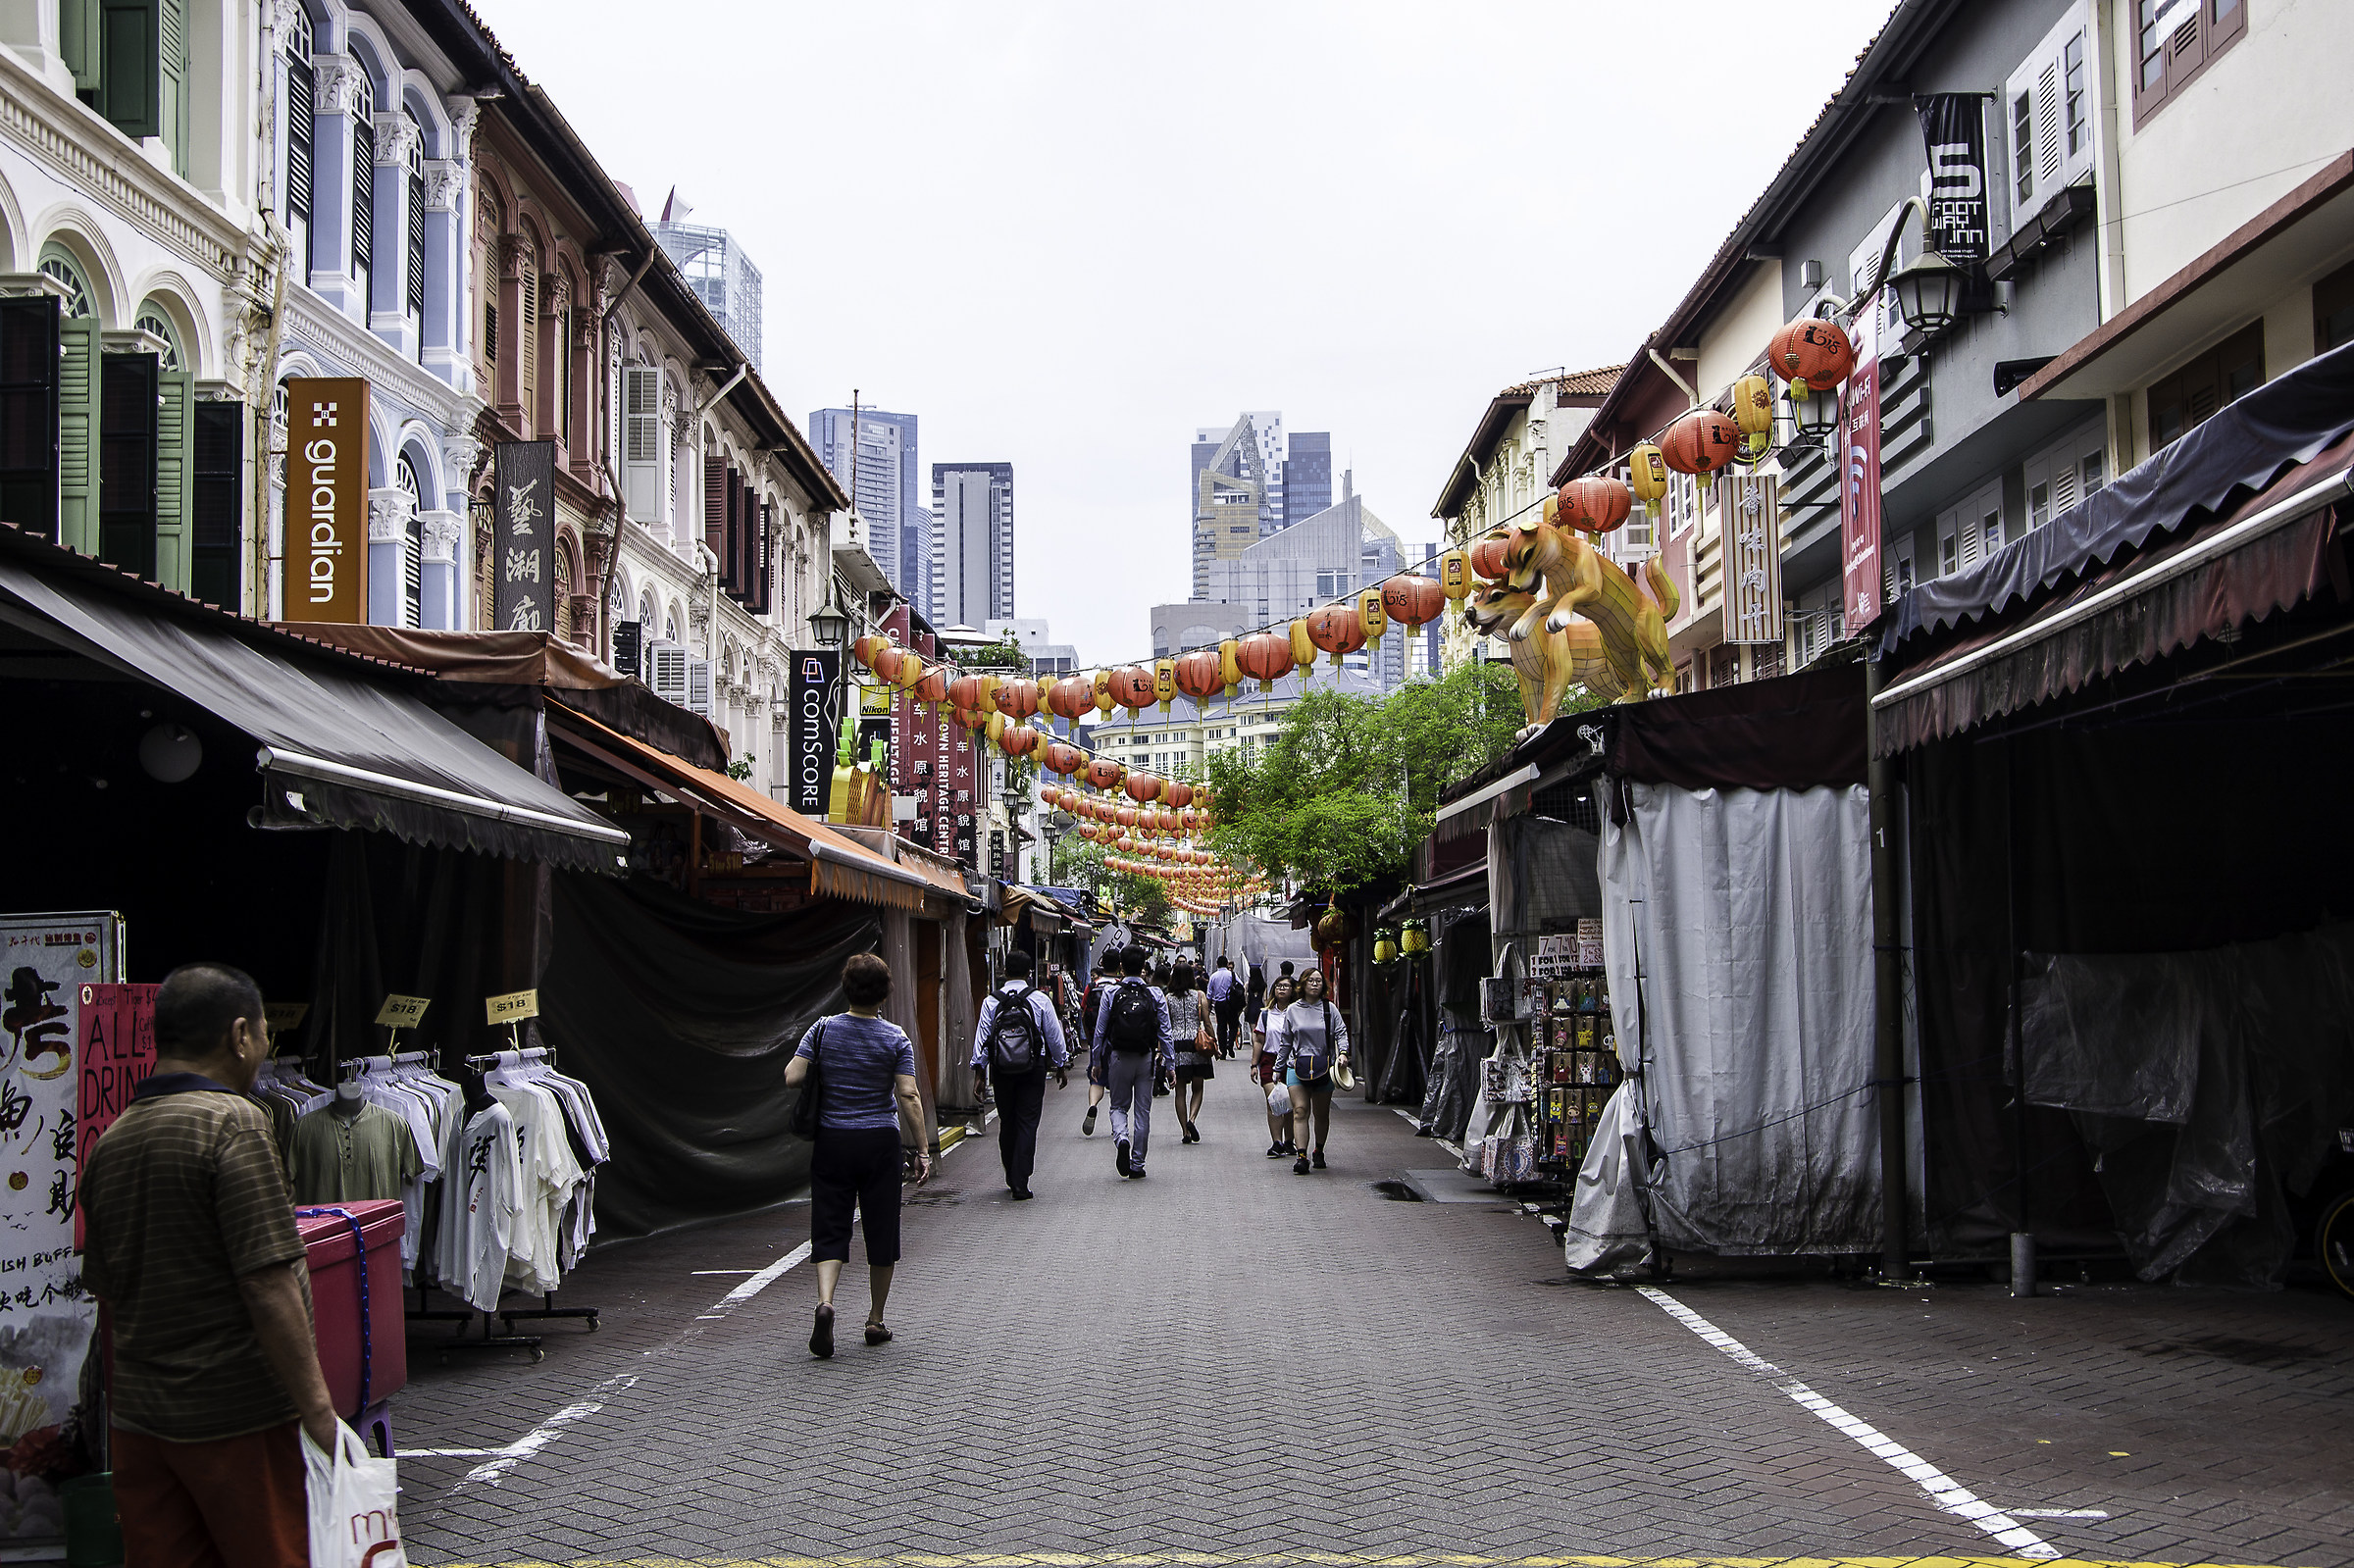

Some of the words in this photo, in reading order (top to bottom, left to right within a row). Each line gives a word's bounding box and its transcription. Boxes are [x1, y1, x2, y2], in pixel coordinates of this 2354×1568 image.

[1930, 143, 1981, 199] 5
[1932, 201, 1982, 216] FOOT
[1932, 216, 1970, 230] WAY
[1852, 374, 1871, 408] Wi-Fi
[304, 438, 343, 603] guardian
[861, 705, 889, 714] Nikon
[938, 755, 949, 812] HERITAGE
[938, 817, 949, 854] CENTR
[124, 988, 143, 1010] Tiger
[496, 999, 526, 1012] $18
[84, 1011, 146, 1065] ALL
[0, 1256, 26, 1274] ISH
[32, 1245, 73, 1269] BUFF
